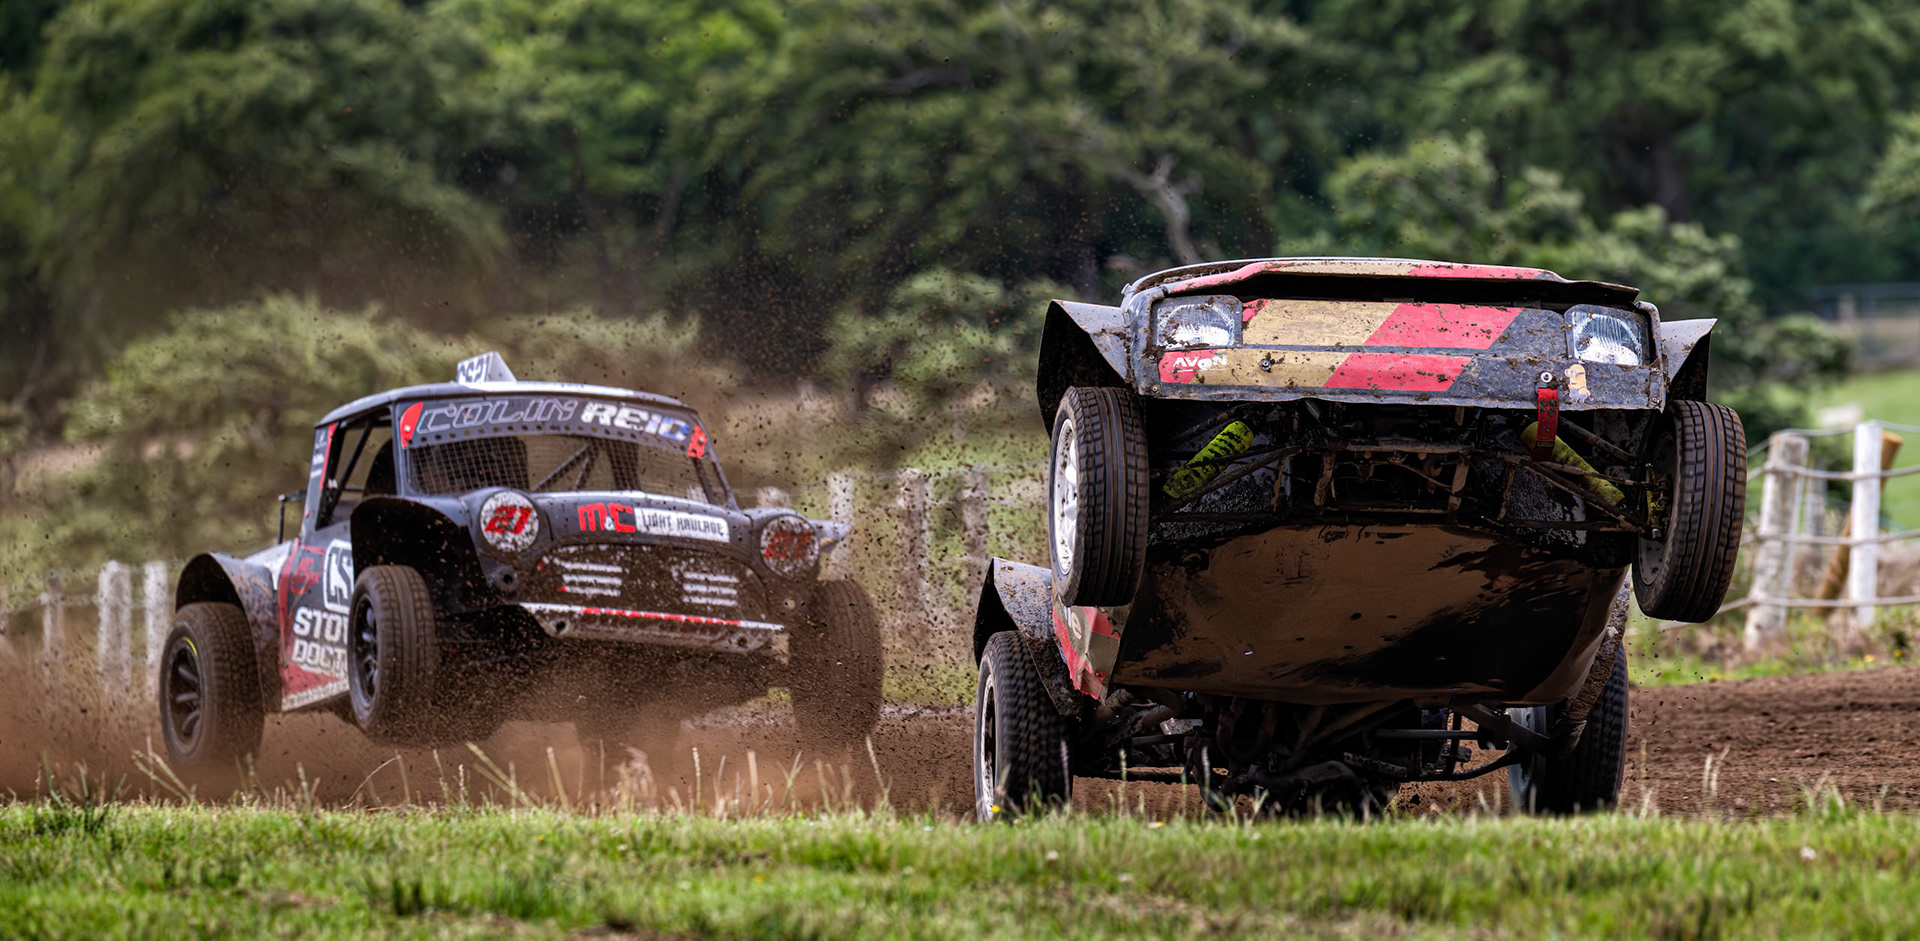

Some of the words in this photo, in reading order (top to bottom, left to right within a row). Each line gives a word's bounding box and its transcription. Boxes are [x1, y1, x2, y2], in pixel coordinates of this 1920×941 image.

[1173, 355, 1228, 370] AVON
[416, 399, 578, 434] COLIN
[580, 401, 691, 441] REID
[485, 504, 533, 535] 21
[676, 516, 723, 535] HAULAGE
